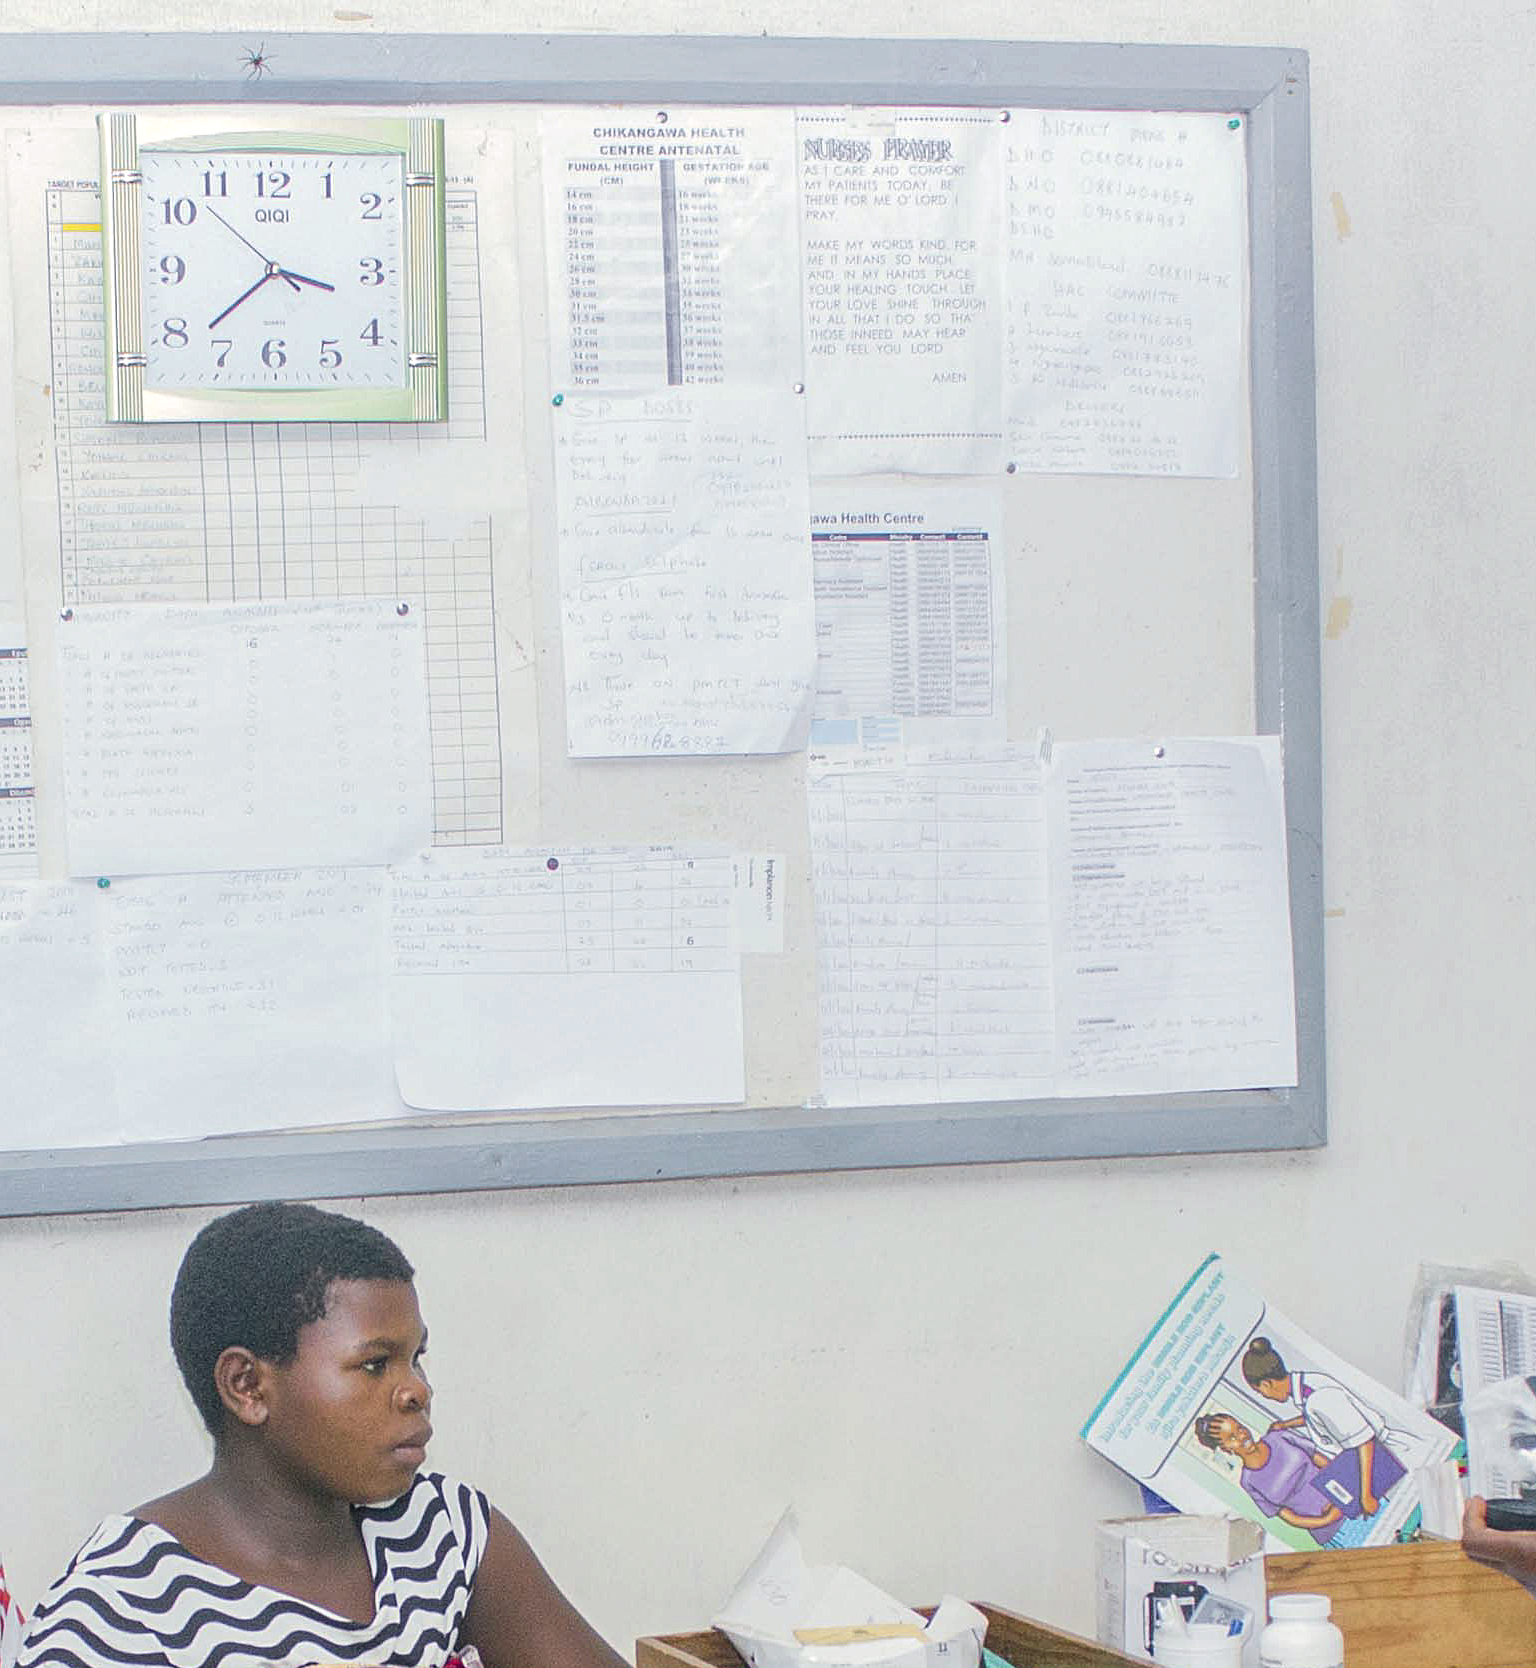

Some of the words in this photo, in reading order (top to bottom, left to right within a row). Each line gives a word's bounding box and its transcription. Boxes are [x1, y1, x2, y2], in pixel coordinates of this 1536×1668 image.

[593, 128, 686, 138] CHIKANGAWA
[691, 128, 745, 138] HEALTH
[600, 146, 654, 155] CENTRE
[659, 146, 739, 155] ANTENATAL
[568, 163, 610, 171] FUNDAL
[615, 163, 654, 171] HEIGHT
[805, 166, 821, 175] AS
[833, 167, 866, 176] CARE
[873, 167, 898, 175] AND
[200, 171, 228, 198] 11
[254, 172, 292, 198] 12
[320, 174, 333, 199] 1
[805, 181, 822, 190] MY
[829, 180, 878, 191] PATIENTS
[805, 195, 838, 205] THERE
[845, 195, 868, 205] FOR
[874, 196, 891, 205] ME
[163, 199, 197, 226] 10
[360, 193, 382, 220] 2
[255, 209, 290, 224] QIQI
[808, 240, 839, 250] MAKE
[846, 240, 863, 250] MY
[871, 240, 913, 250] WORDS
[955, 240, 976, 251] FOR
[808, 256, 823, 265] ME
[846, 255, 886, 265] MEANS
[896, 255, 911, 265] SO
[160, 256, 186, 285] 9
[360, 257, 384, 286] 3
[808, 270, 834, 280] AND
[844, 270, 855, 280] IN
[863, 270, 880, 280] MY
[887, 269, 926, 280] HANDS
[808, 284, 840, 295] YOUR
[848, 284, 896, 295] HEALING
[959, 284, 975, 294] LET
[809, 299, 840, 310] YOUR
[848, 299, 877, 310] LOVE
[887, 299, 919, 310] SHINE
[933, 298, 986, 310] THROUGH
[809, 314, 820, 324] IN
[827, 314, 846, 324] ALL
[854, 314, 880, 324] THAT
[896, 314, 914, 324] DO
[925, 314, 941, 324] SO
[163, 319, 189, 348] 8
[360, 319, 384, 346] 4
[811, 329, 846, 340] THOSE
[903, 328, 929, 339] MAY
[211, 340, 232, 368] 7
[262, 340, 287, 368] 6
[320, 340, 343, 368] 5
[811, 344, 836, 354] AND
[846, 344, 869, 353] FEEL
[878, 344, 901, 354] YOU
[911, 344, 943, 354] LORD
[932, 372, 967, 383] AMEN
[841, 513, 880, 524] Health
[884, 513, 924, 524] Centre
